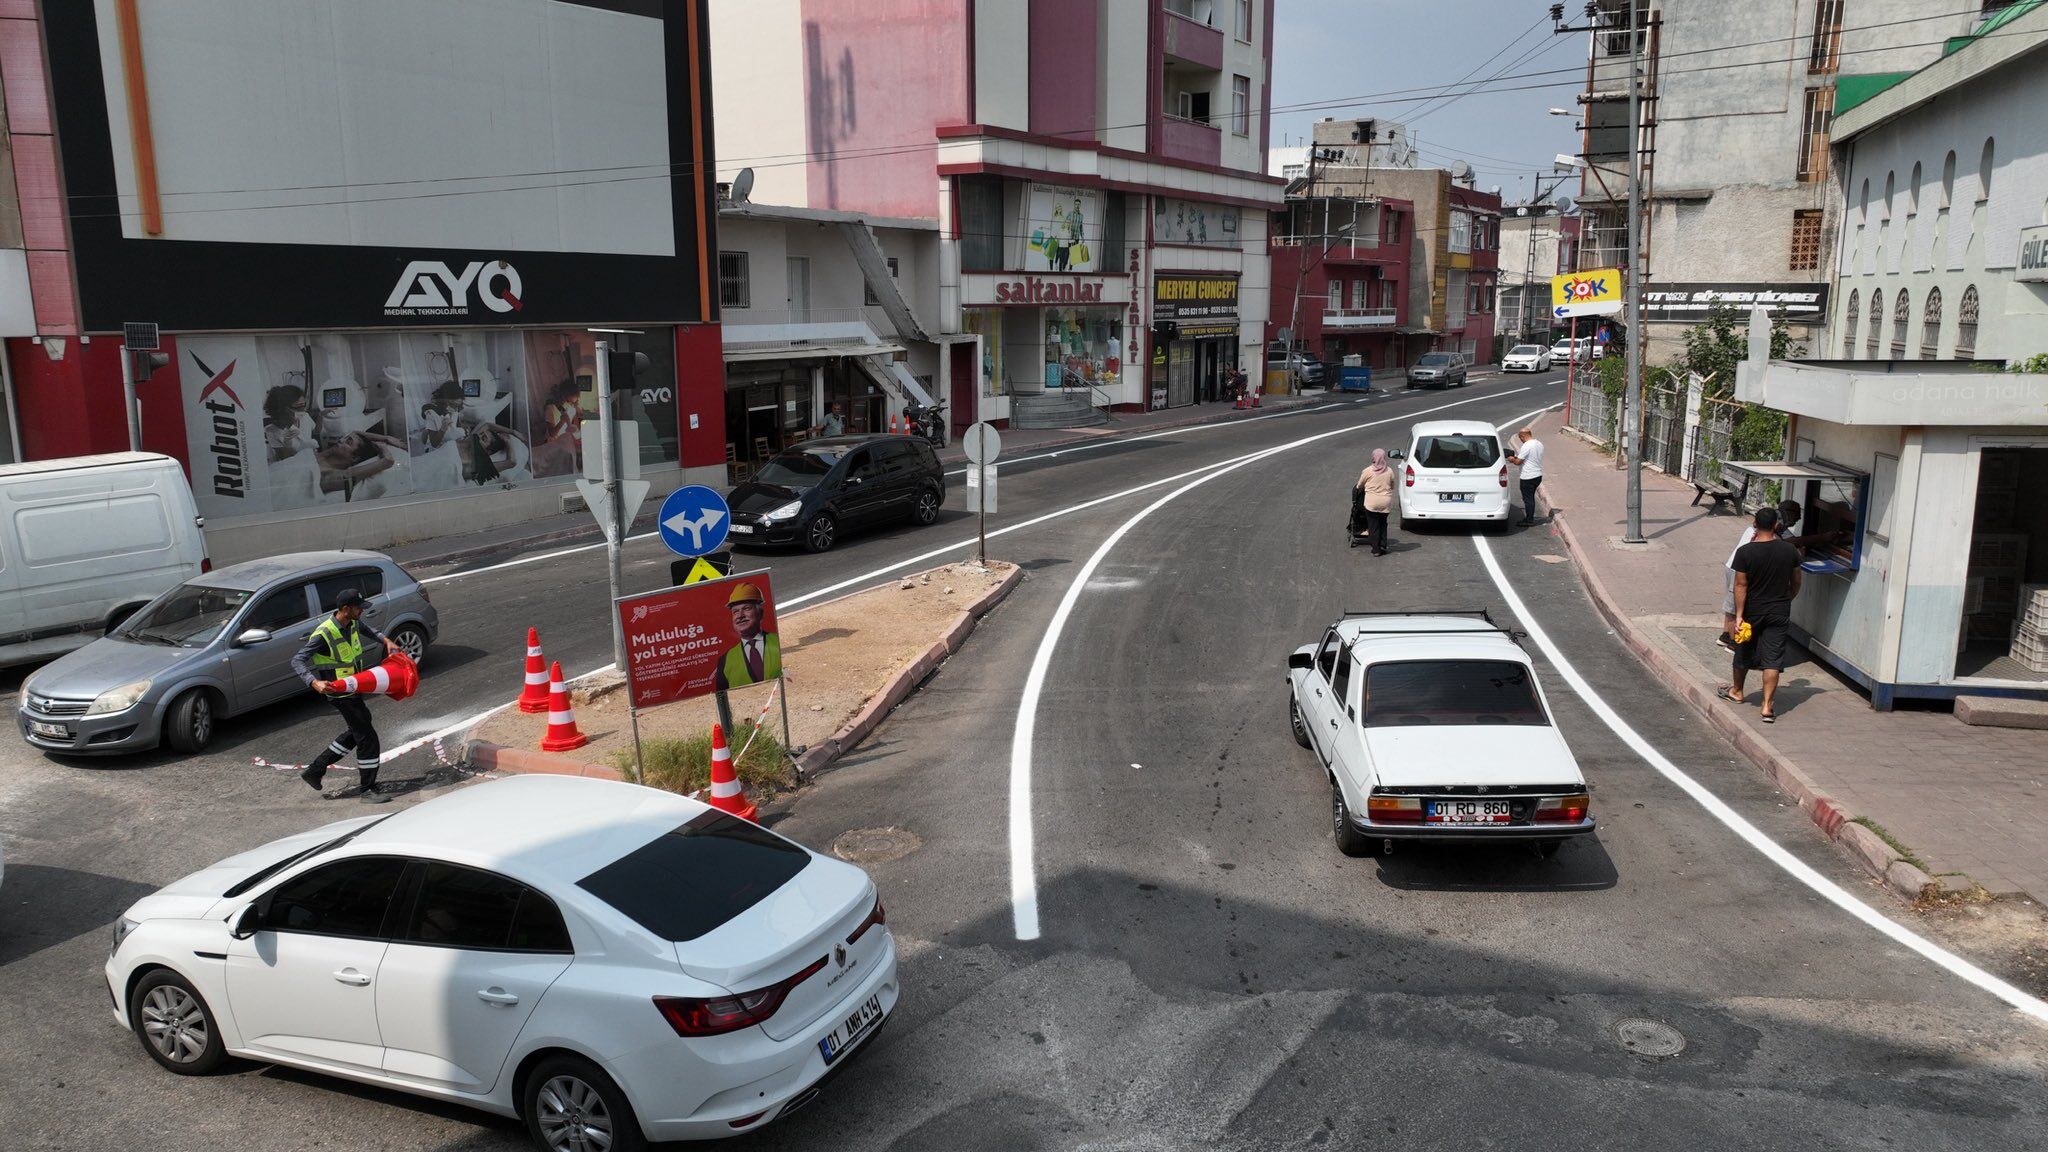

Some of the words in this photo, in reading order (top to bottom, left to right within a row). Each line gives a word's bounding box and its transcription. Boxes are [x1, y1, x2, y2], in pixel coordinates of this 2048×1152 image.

[384, 260, 523, 312] AYQ
[996, 277, 1103, 304] saltanlar
[1158, 280, 1197, 299] MERYEM
[1199, 281, 1237, 299] CONCEPT
[1563, 278, 1608, 303] ŞOK
[1129, 249, 1139, 363] saltanlar
[1893, 381, 1976, 401] adana
[632, 624, 704, 647] Mutluluğa
[634, 646, 657, 663] yol
[660, 636, 722, 657] açıyoruz.
[1435, 803, 1449, 815] 01
[1456, 803, 1476, 815] RD
[1484, 802, 1509, 815] 860
[827, 1029, 841, 1052] 01
